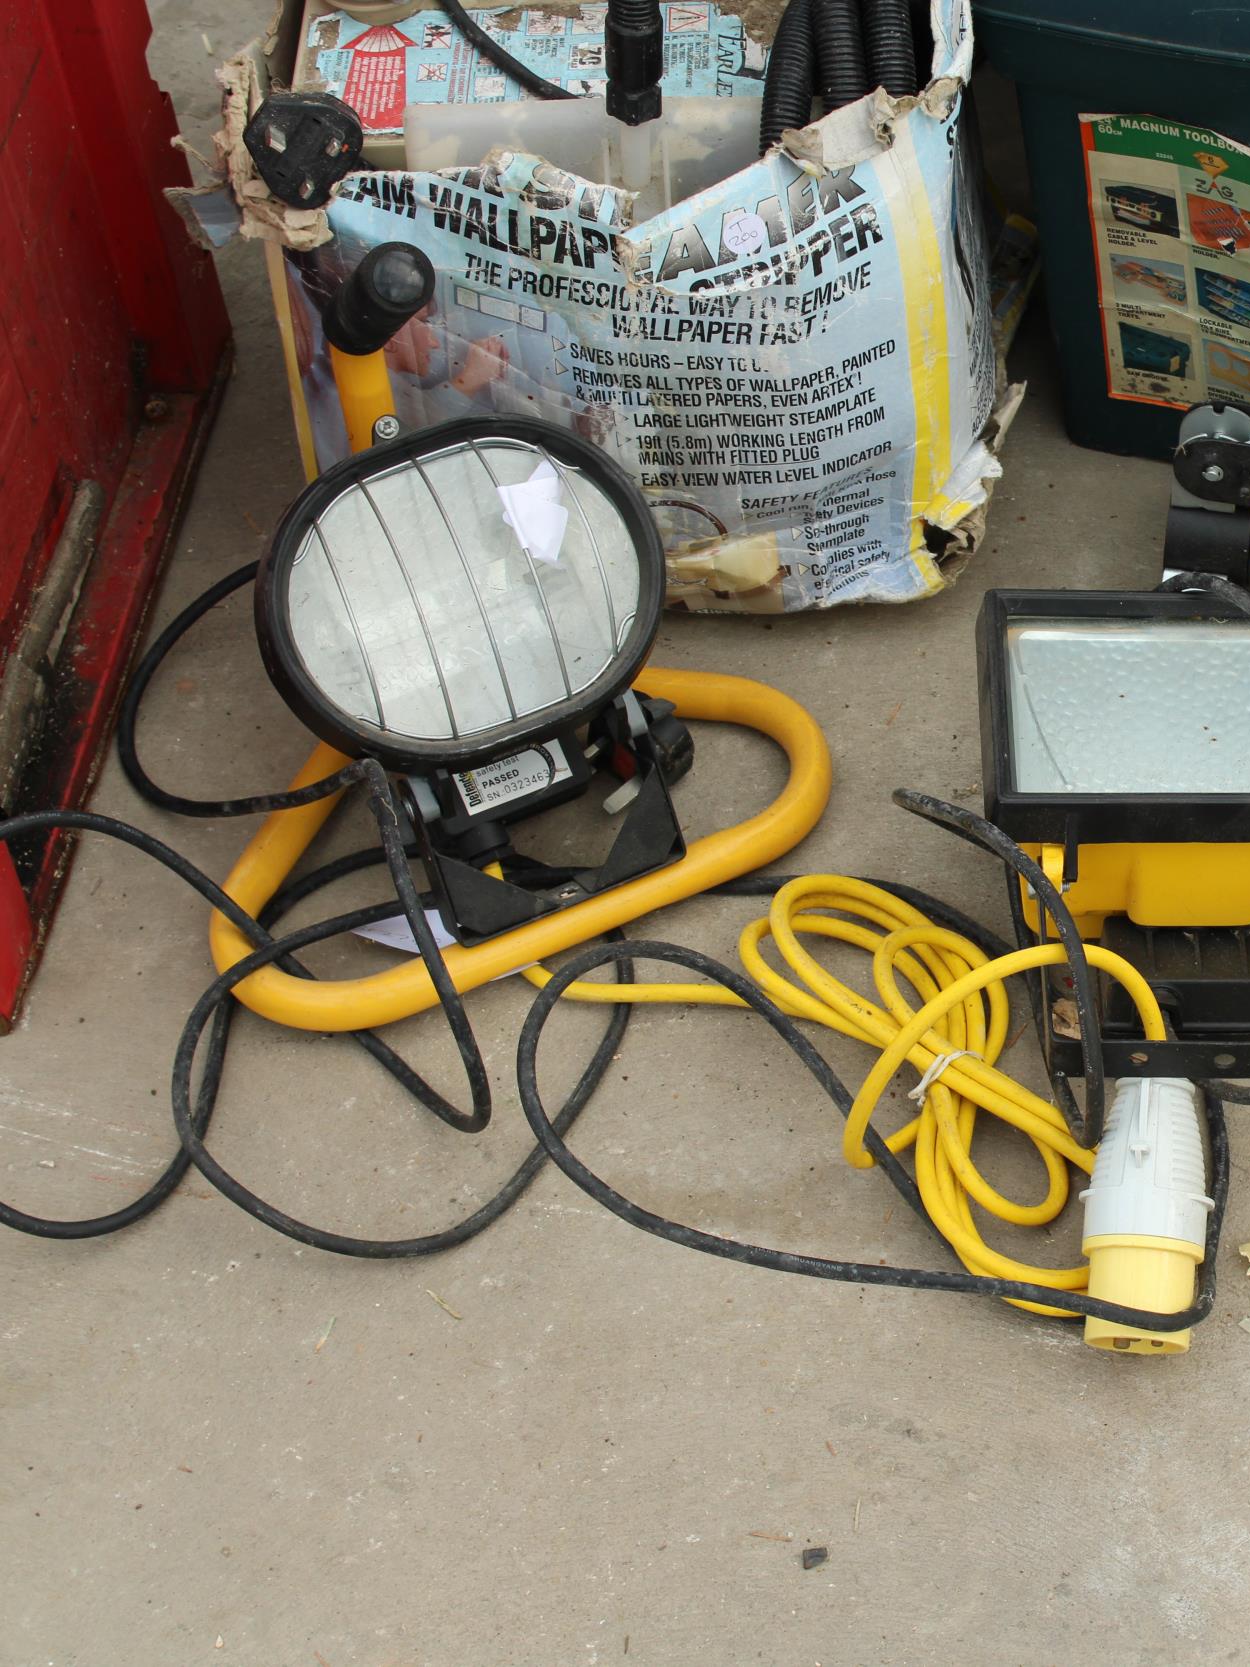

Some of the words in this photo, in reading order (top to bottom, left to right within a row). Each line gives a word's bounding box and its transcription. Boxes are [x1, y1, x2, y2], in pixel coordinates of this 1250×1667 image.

[716, 34, 748, 98] EARLE
[1120, 117, 1180, 137] MAGNUM
[728, 229, 759, 247] 200
[1106, 227, 1147, 238] REMOVABLE
[1107, 233, 1129, 242] CABLE
[1137, 236, 1158, 246] LEVEL
[1108, 238, 1137, 248] HOLDER.
[464, 252, 502, 287] THE
[507, 266, 680, 316] PROFESSIONAL
[690, 295, 741, 319] WAY
[749, 295, 777, 320] TO
[784, 261, 872, 318] REMOVE
[612, 312, 752, 345] WALLPAPER
[760, 314, 816, 346] FAST
[1199, 318, 1233, 330] LOCKABLE
[570, 342, 614, 366] SAVES
[618, 352, 671, 369] HOURS
[687, 355, 724, 371] EASY
[728, 357, 747, 372] TO
[572, 366, 642, 389] REMOVES
[646, 375, 673, 391] ALL
[676, 376, 722, 391] TYPES
[726, 378, 745, 392] OF
[749, 365, 839, 392] WALLPAPER,
[842, 339, 896, 375] PAINTED
[576, 385, 585, 400] &
[637, 391, 701, 407] LAYERED
[706, 392, 767, 410] PAPERS,
[771, 391, 807, 408] EVEN
[633, 413, 682, 428] LARGE
[686, 412, 785, 428] LIGHTWEIGHT
[789, 387, 876, 426] STEAMPLATE
[635, 434, 662, 449] 19ft
[667, 435, 713, 453] (5.8m)
[716, 432, 785, 448] WORKING
[790, 423, 843, 447] LENGTH
[847, 406, 885, 433] FROM
[639, 451, 683, 466] MAINS
[690, 449, 726, 465] WITH
[730, 449, 778, 465] FITTED
[782, 445, 820, 463] PLUG
[723, 470, 773, 486] WATER
[776, 466, 819, 484] LEVEL
[822, 440, 892, 476] INDICATOR
[865, 470, 897, 484] Hose
[742, 493, 800, 510] SAFETY
[837, 496, 885, 516] Devices
[756, 508, 784, 520] Cool
[857, 538, 882, 554] with
[476, 760, 501, 778] safety
[503, 755, 520, 767] test
[482, 769, 520, 789] PASSED
